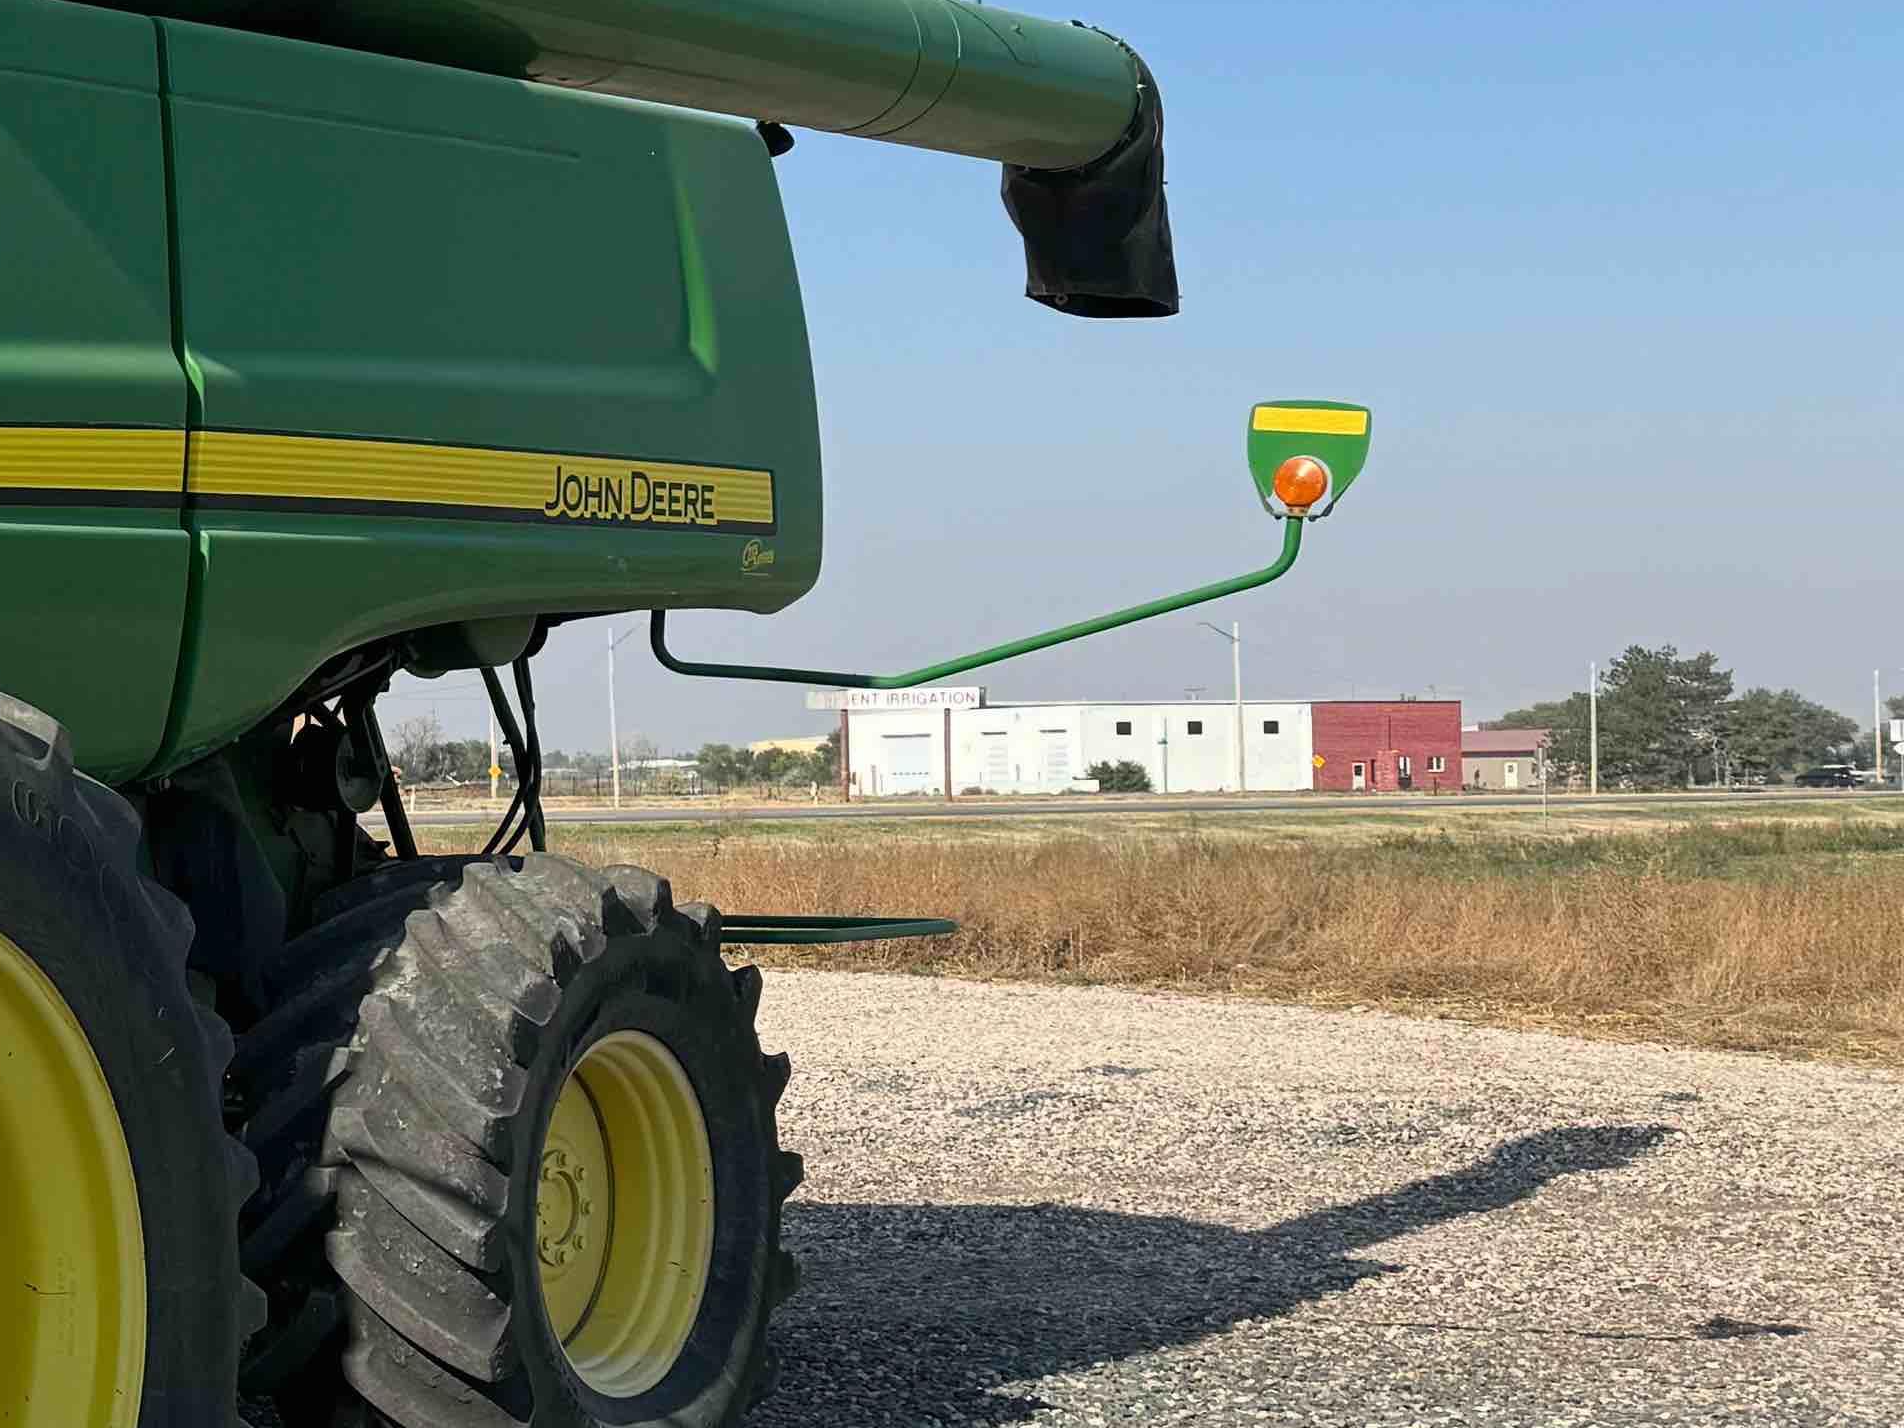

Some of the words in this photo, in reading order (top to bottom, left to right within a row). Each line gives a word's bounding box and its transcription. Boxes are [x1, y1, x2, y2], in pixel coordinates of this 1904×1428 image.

[544, 465, 623, 514] JOHN
[630, 471, 716, 520] DEERE
[886, 691, 976, 706] IRRIGATION
